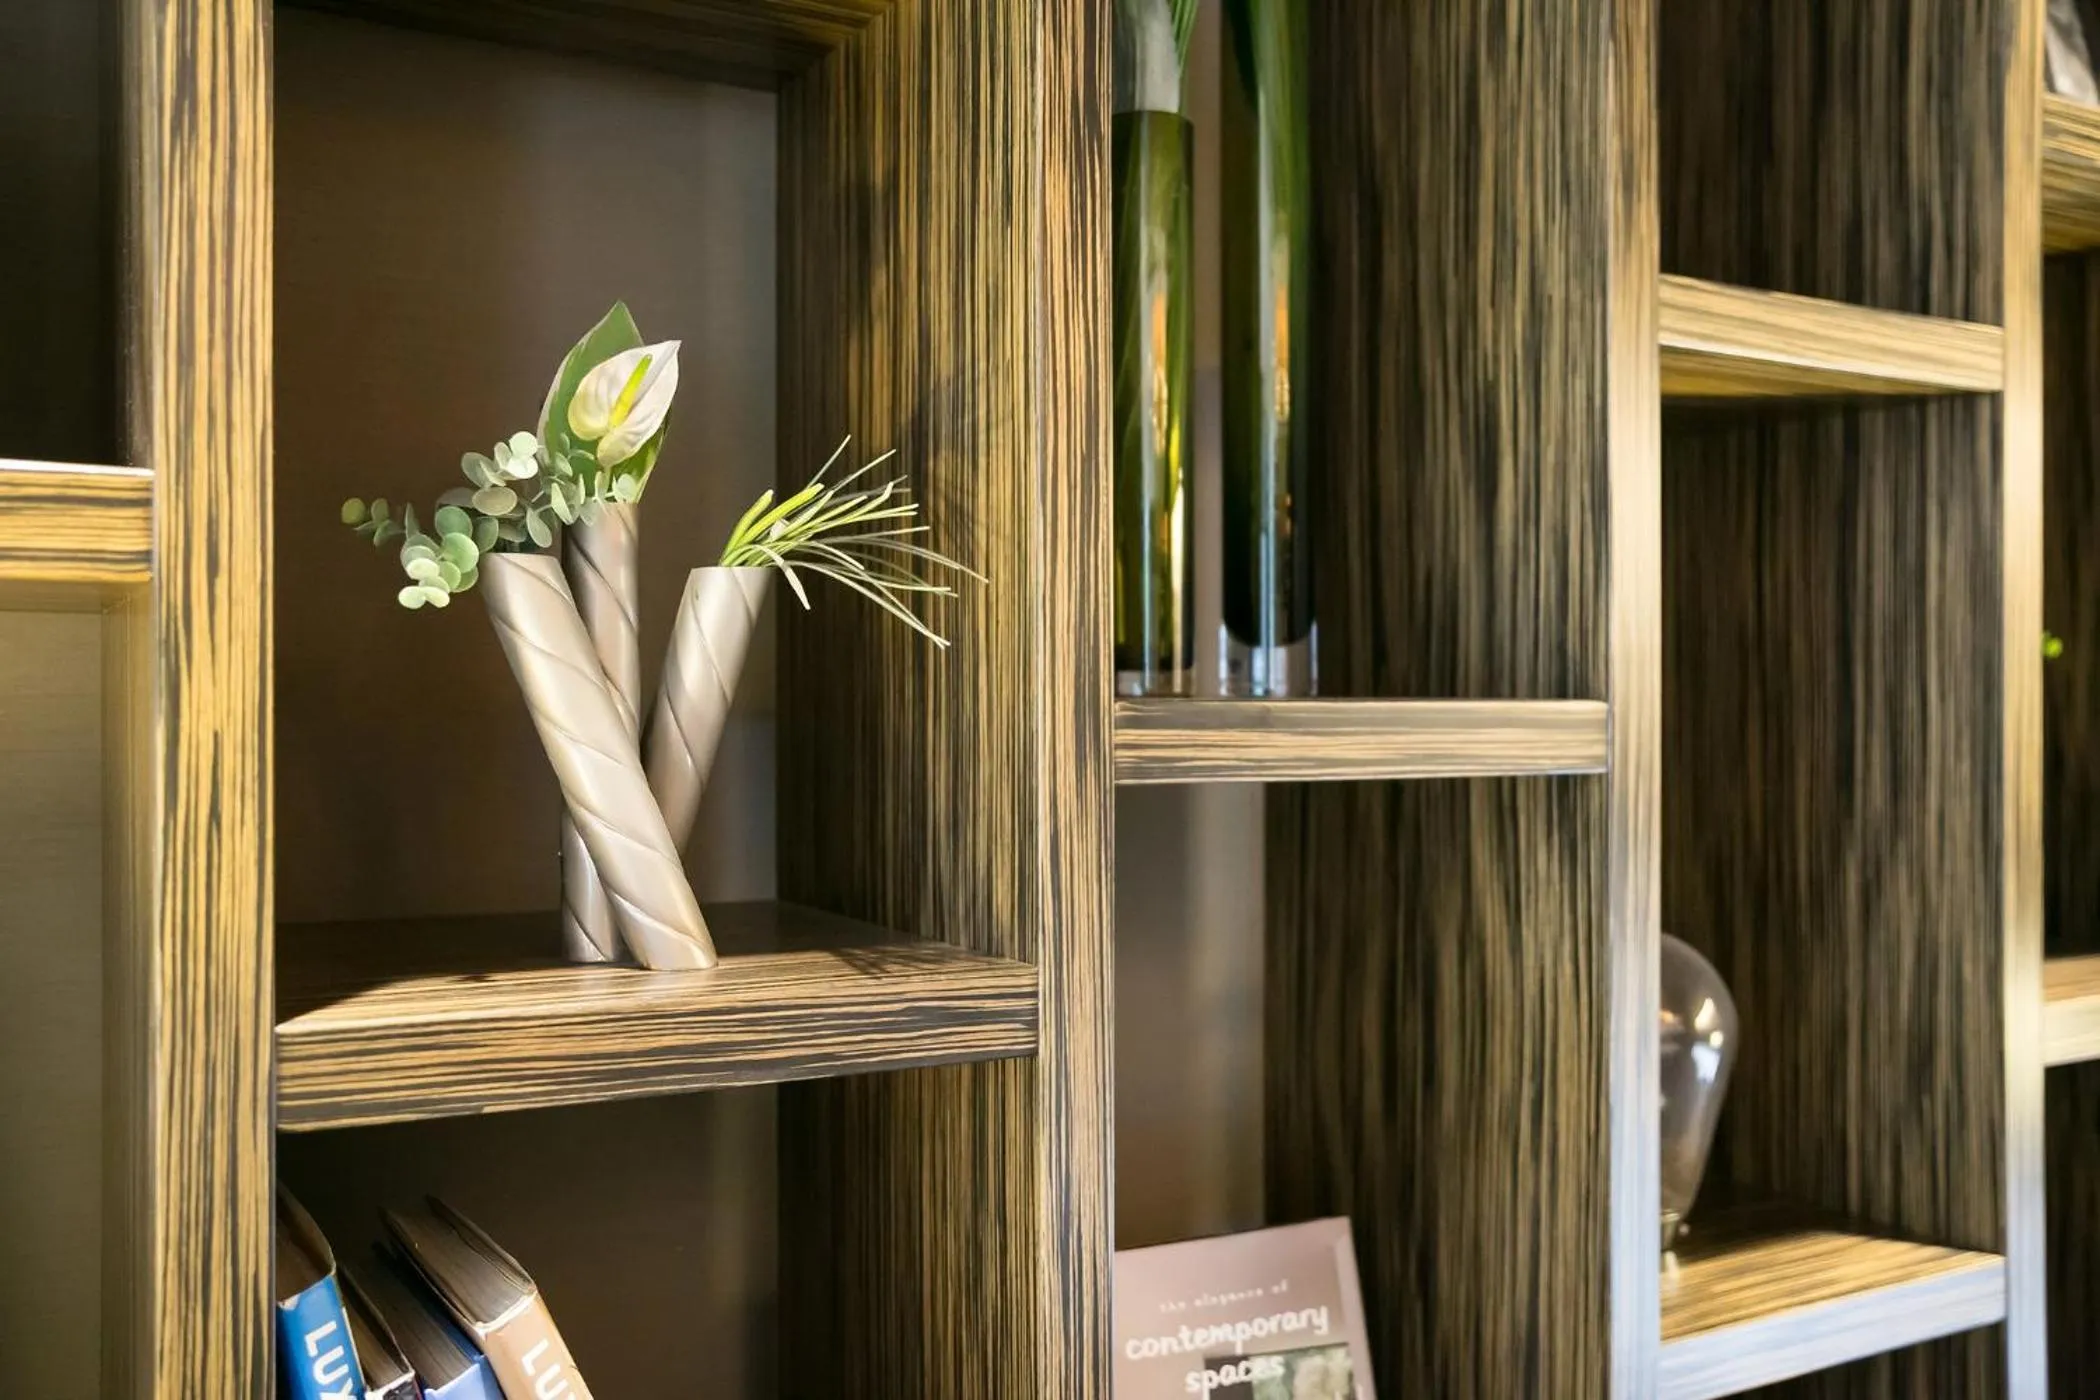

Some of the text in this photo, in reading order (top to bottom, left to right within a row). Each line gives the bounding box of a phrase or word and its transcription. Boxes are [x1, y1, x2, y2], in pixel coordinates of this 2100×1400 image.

[1125, 1305, 1329, 1360] contemporary
[521, 1338, 577, 1400] LU
[1185, 1355, 1286, 1400] spaces
